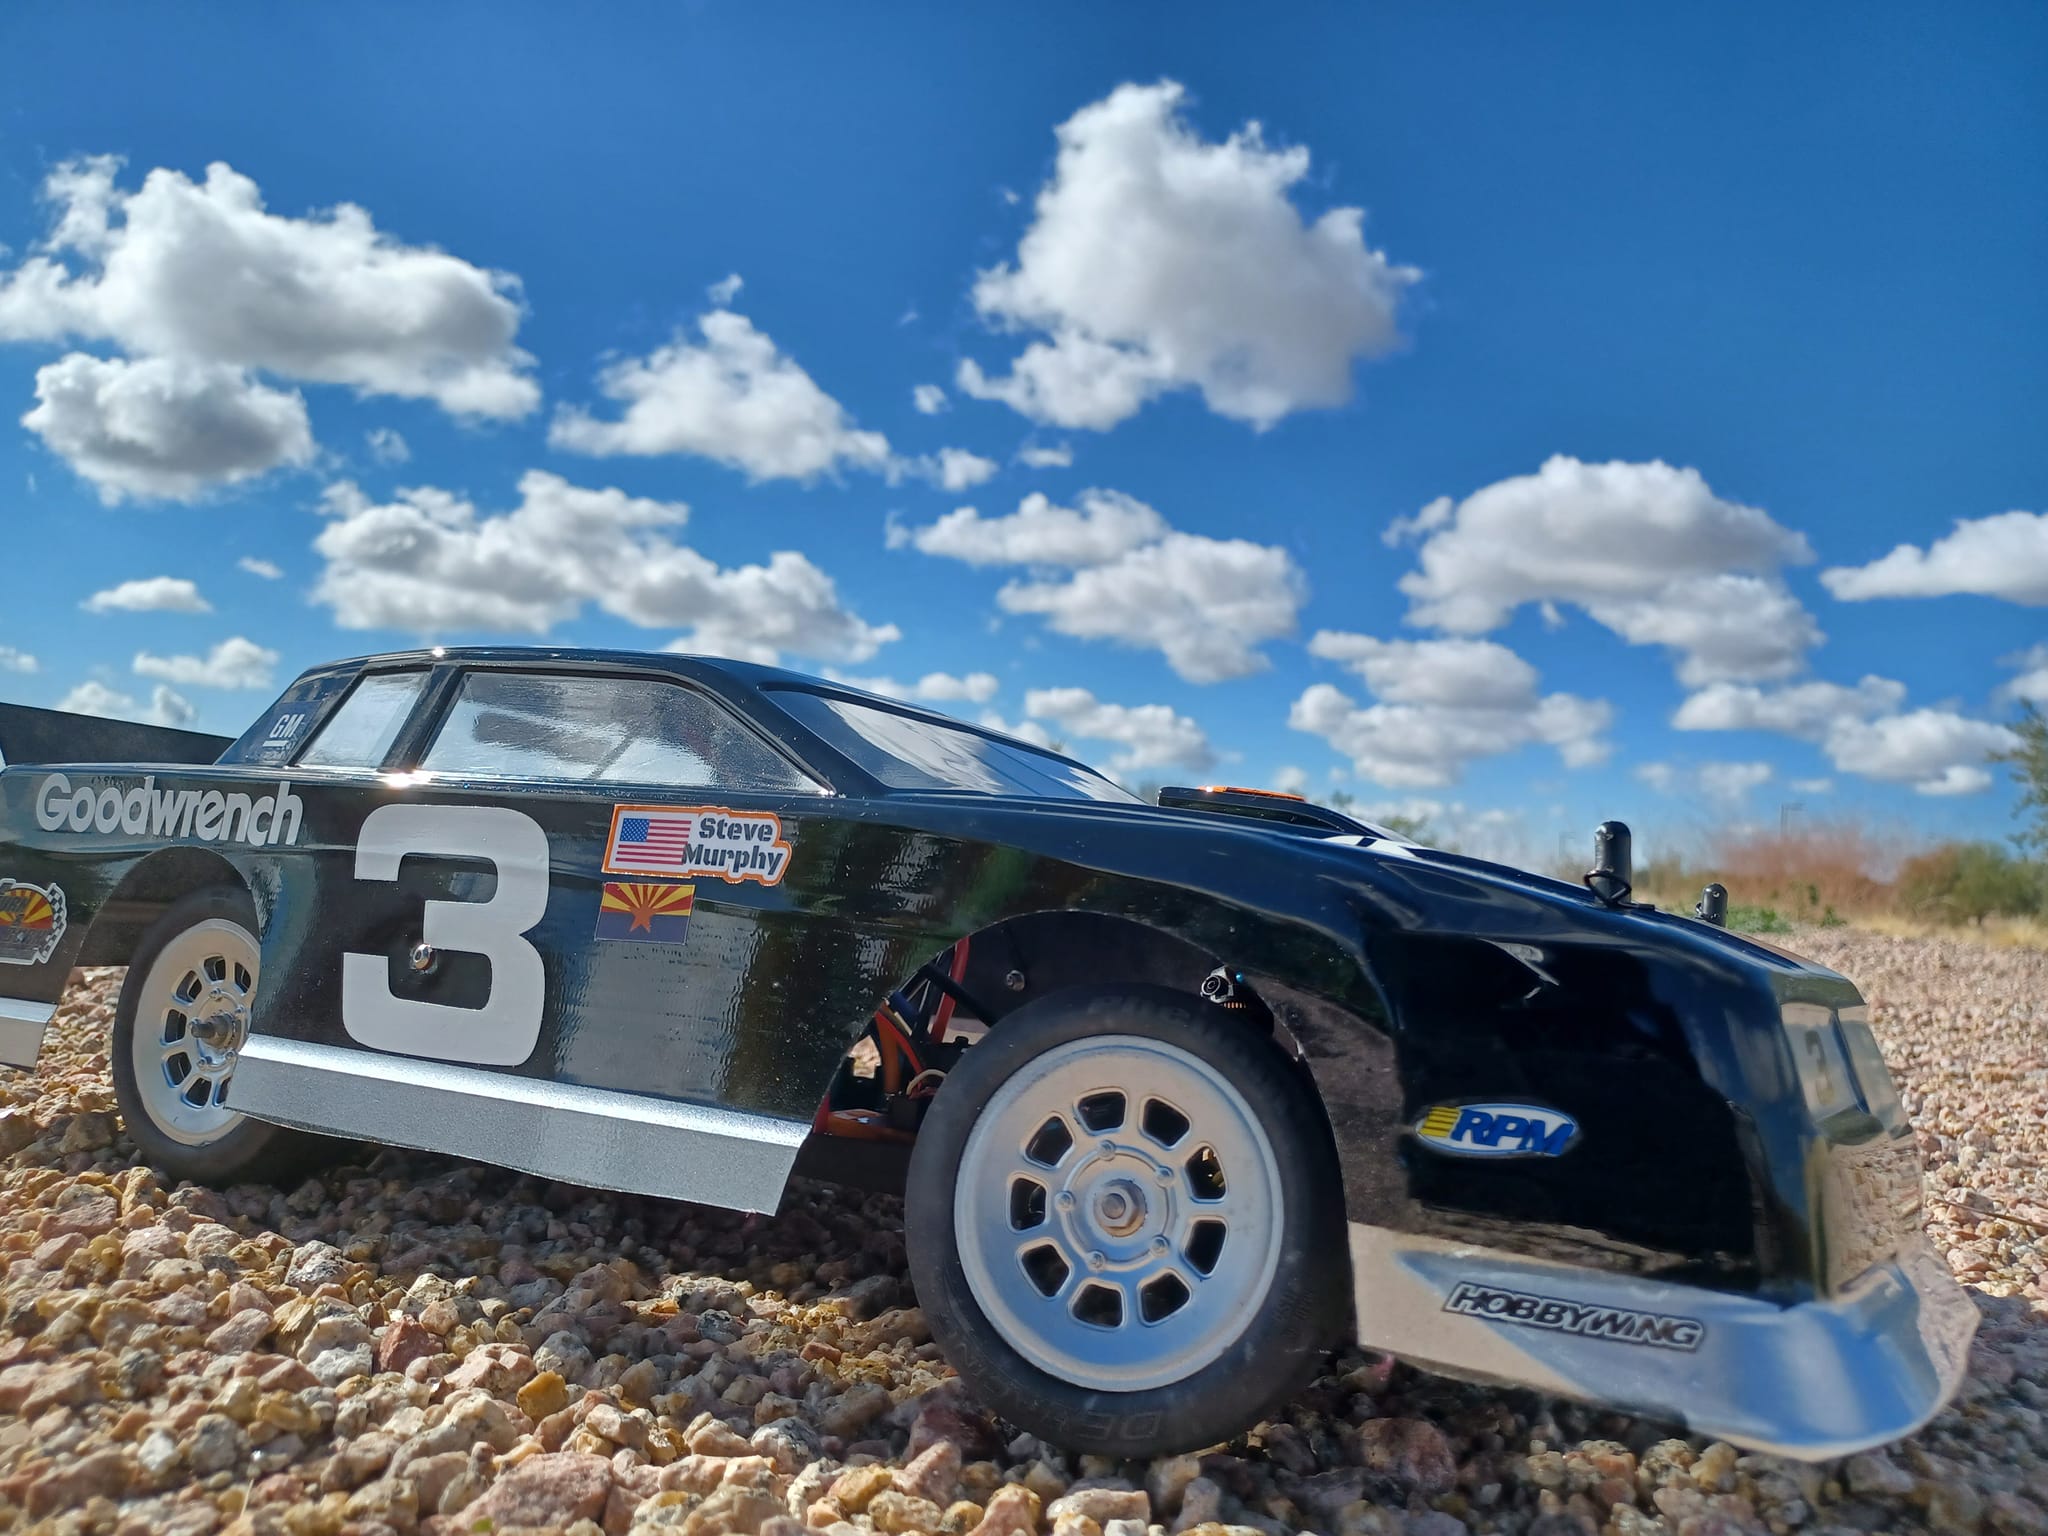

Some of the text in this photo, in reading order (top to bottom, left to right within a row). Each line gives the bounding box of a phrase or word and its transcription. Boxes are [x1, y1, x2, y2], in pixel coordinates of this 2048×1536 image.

[269, 713, 305, 738] GM
[36, 773, 303, 847] Goodwrench
[699, 817, 774, 842] Steve
[681, 843, 783, 876] Murphy
[343, 803, 550, 1067] 3
[1450, 1108, 1574, 1155] RPM
[1447, 1284, 1701, 1349] HOBBYWING
